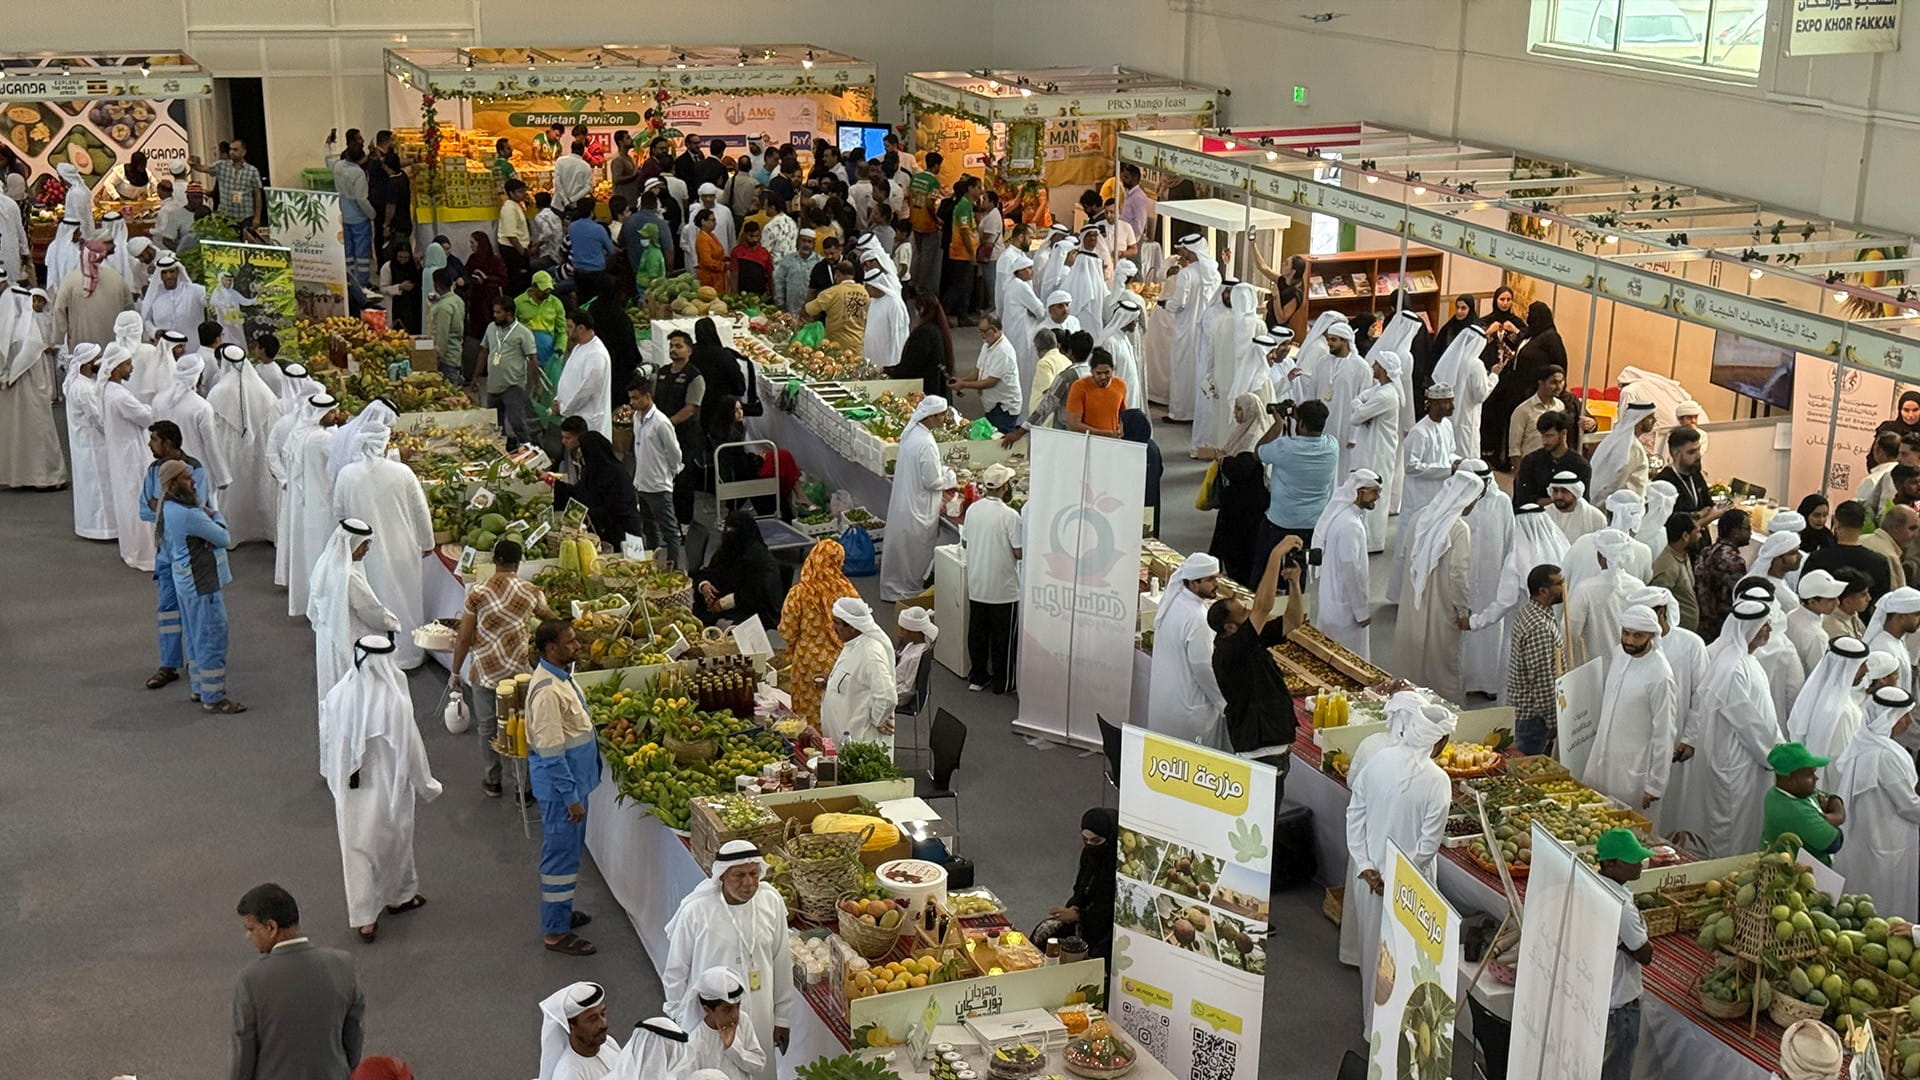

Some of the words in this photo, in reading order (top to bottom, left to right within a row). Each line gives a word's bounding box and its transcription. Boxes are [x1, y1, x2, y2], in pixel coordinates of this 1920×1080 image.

[1796, 18, 1822, 32] EXPO
[1824, 17, 1853, 31] KHOR
[1855, 15, 1896, 30] FAKKAN
[748, 107, 776, 117] AMG
[1107, 98, 1132, 110] PBCS
[1133, 98, 1163, 111] Mango
[1164, 97, 1187, 108] feast
[526, 114, 576, 125] Pakistan
[1505, 244, 1527, 260] للتراث
[1526, 250, 1551, 269] الشارقة
[1709, 301, 1739, 319] الطبيعية
[1780, 319, 1800, 337] البيئة
[1801, 324, 1818, 342] هيئة
[1148, 756, 1190, 782] النور
[1193, 765, 1244, 800] مزرعة
[1395, 880, 1417, 915] النور
[1417, 897, 1442, 944] مزرعة
[965, 984, 997, 1001] مهرجان
[955, 993, 1003, 1015] خورفكان
